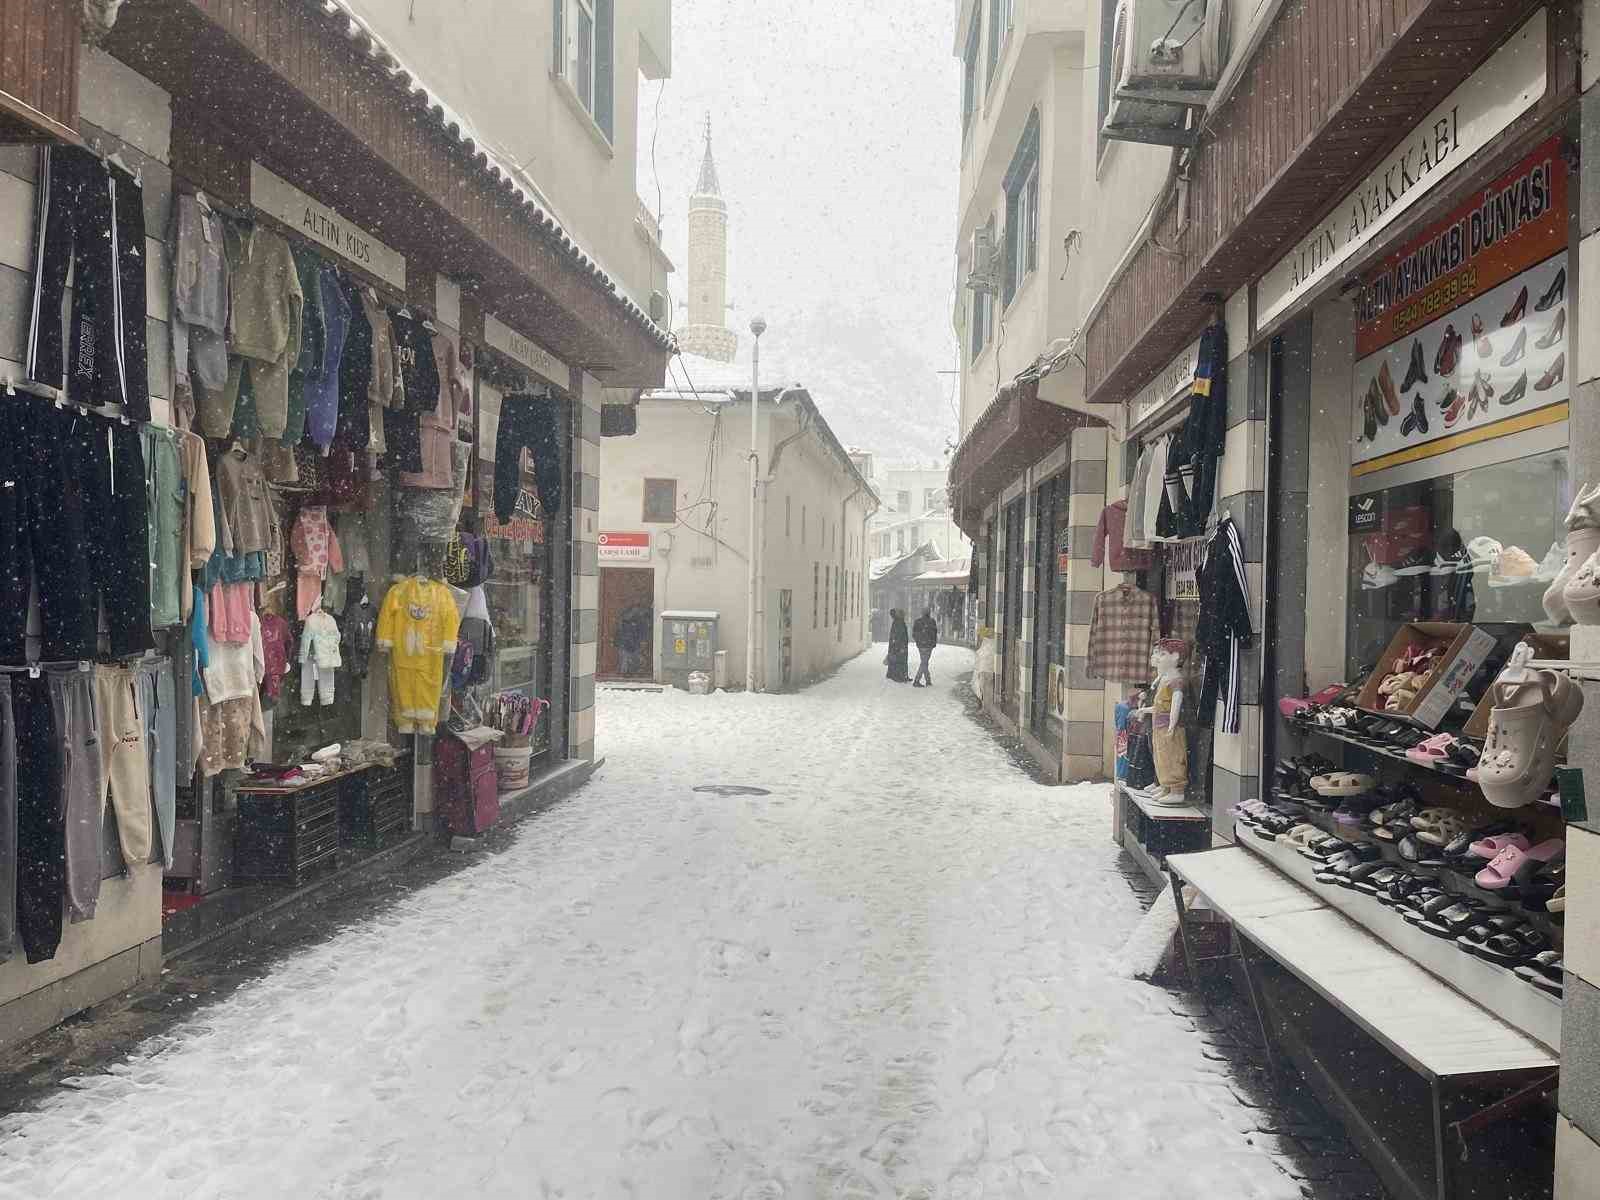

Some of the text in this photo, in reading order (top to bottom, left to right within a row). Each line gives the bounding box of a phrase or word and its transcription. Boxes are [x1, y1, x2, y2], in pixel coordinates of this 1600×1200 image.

[1289, 106, 1461, 292] ALTIN AYAKKABI
[1394, 219, 1466, 304] AYAKKABI
[1469, 160, 1552, 257] DÜNYASI
